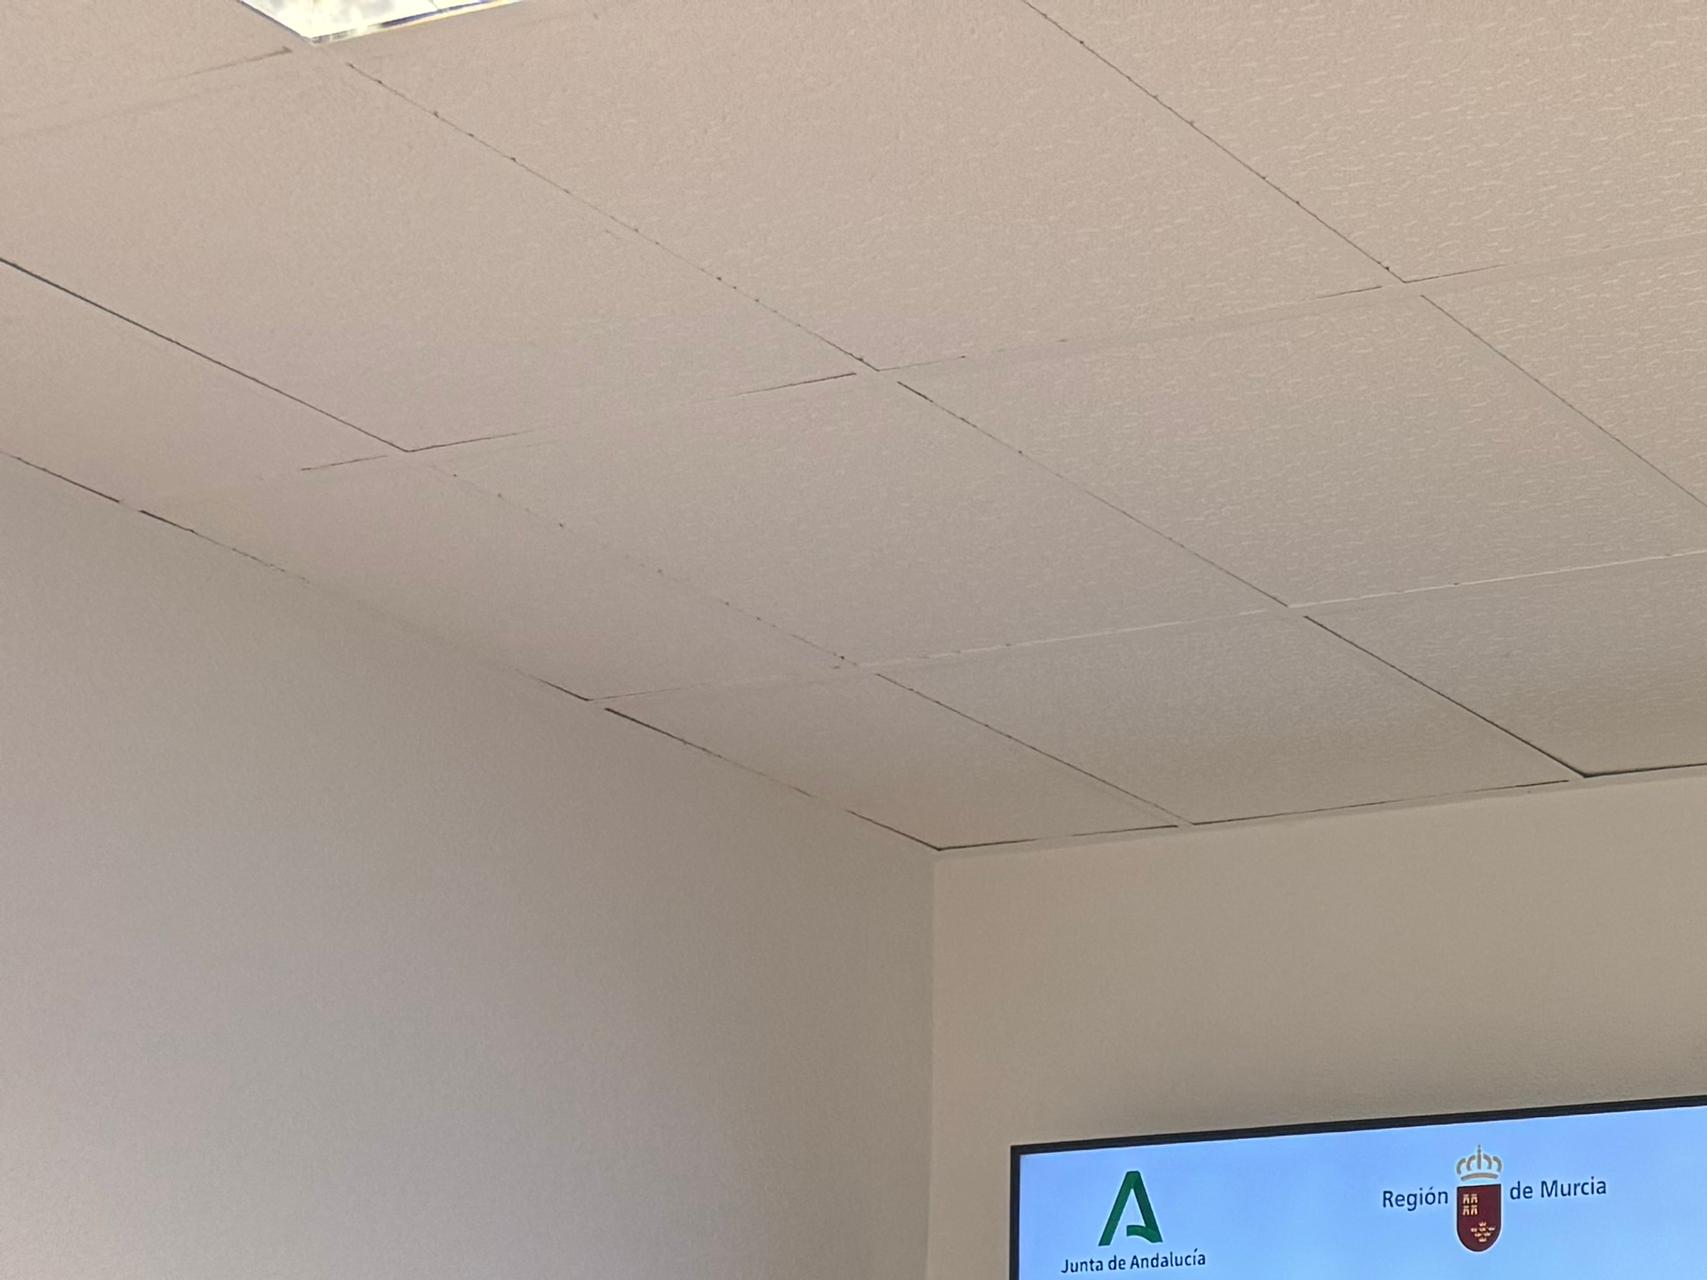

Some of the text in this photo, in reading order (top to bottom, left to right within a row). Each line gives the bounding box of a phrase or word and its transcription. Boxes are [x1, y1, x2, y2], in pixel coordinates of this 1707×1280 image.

[1382, 1176, 1608, 1212] Región de Murcia
[1061, 1247, 1206, 1274] Junta de Andalucía
